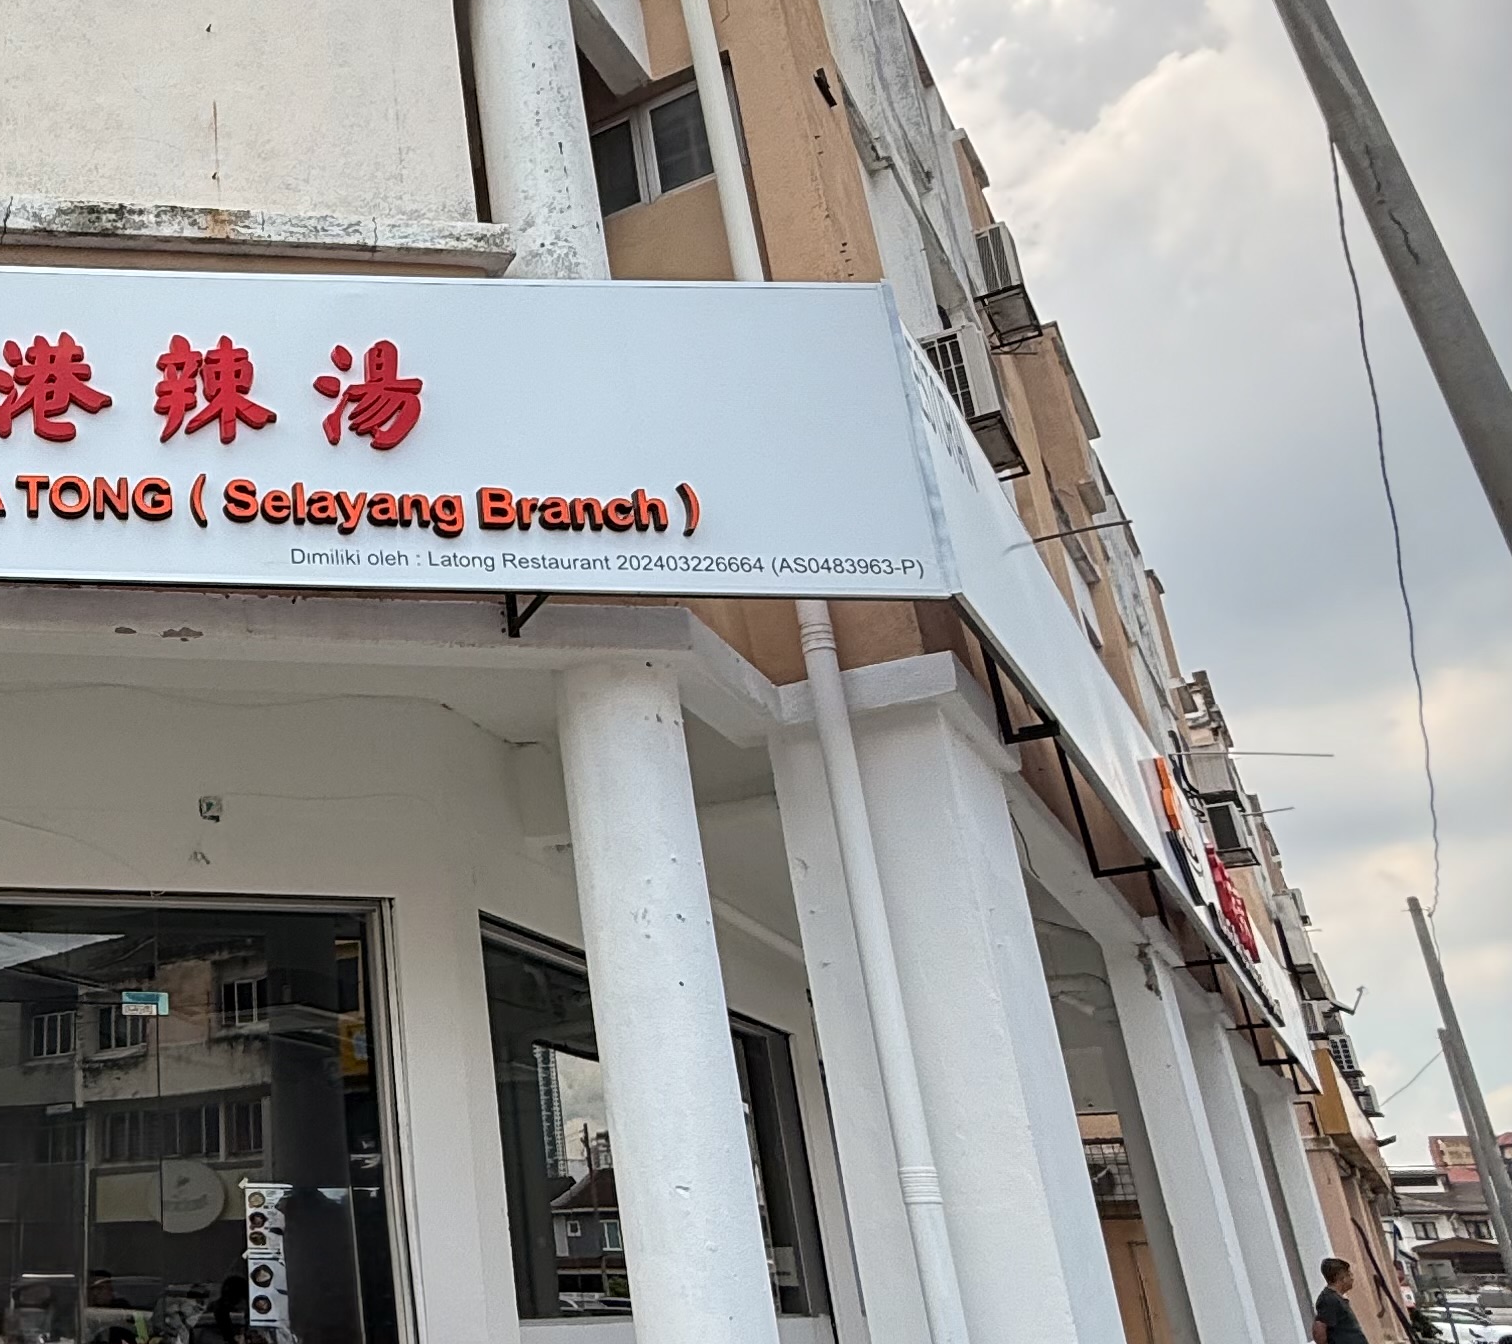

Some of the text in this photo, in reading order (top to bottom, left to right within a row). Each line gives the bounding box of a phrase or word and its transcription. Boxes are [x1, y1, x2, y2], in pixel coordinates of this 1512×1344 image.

[16, 474, 174, 521] TONG
[222, 477, 466, 538] Selayang
[476, 486, 670, 533] Branch
[290, 547, 361, 566] Dimiliki
[367, 549, 409, 567] oleh
[427, 550, 495, 572] Latong
[501, 552, 612, 571] Restaurant
[616, 554, 765, 573] 202403226664
[771, 555, 925, 579] (AS0483963-P)
